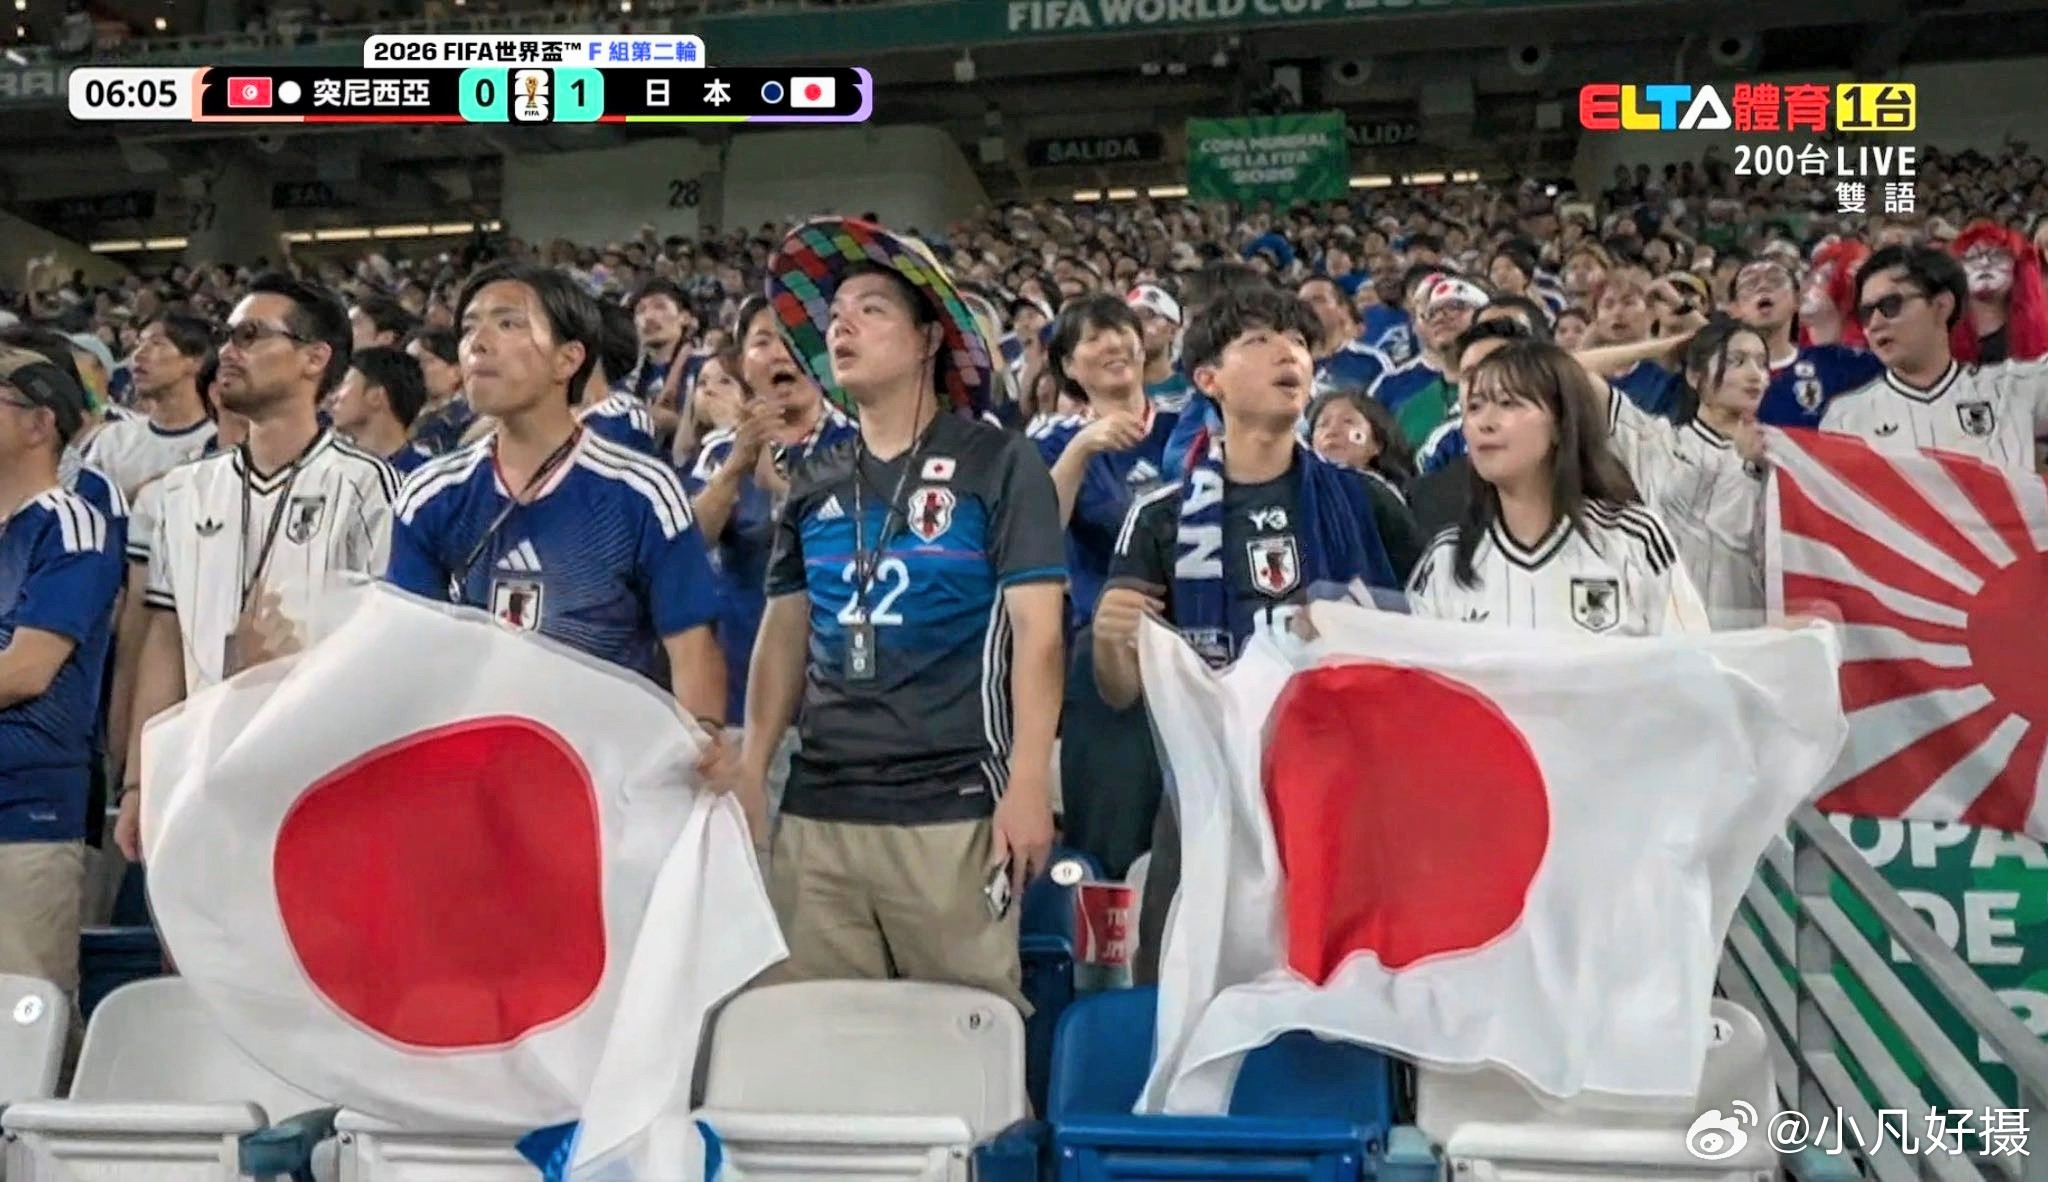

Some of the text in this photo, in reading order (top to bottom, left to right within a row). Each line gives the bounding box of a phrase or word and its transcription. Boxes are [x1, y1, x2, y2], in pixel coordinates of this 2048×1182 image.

[1008, 0, 1094, 31] FIFA
[1099, 0, 1244, 25] WORLD
[1048, 138, 1140, 163] SALIDA
[1345, 122, 1415, 145] ALIDA
[669, 179, 701, 208] 28
[1175, 466, 1223, 579] AN
[837, 558, 910, 625] 22
[1828, 813, 2048, 868] OPA
[1890, 891, 2026, 965] DE
